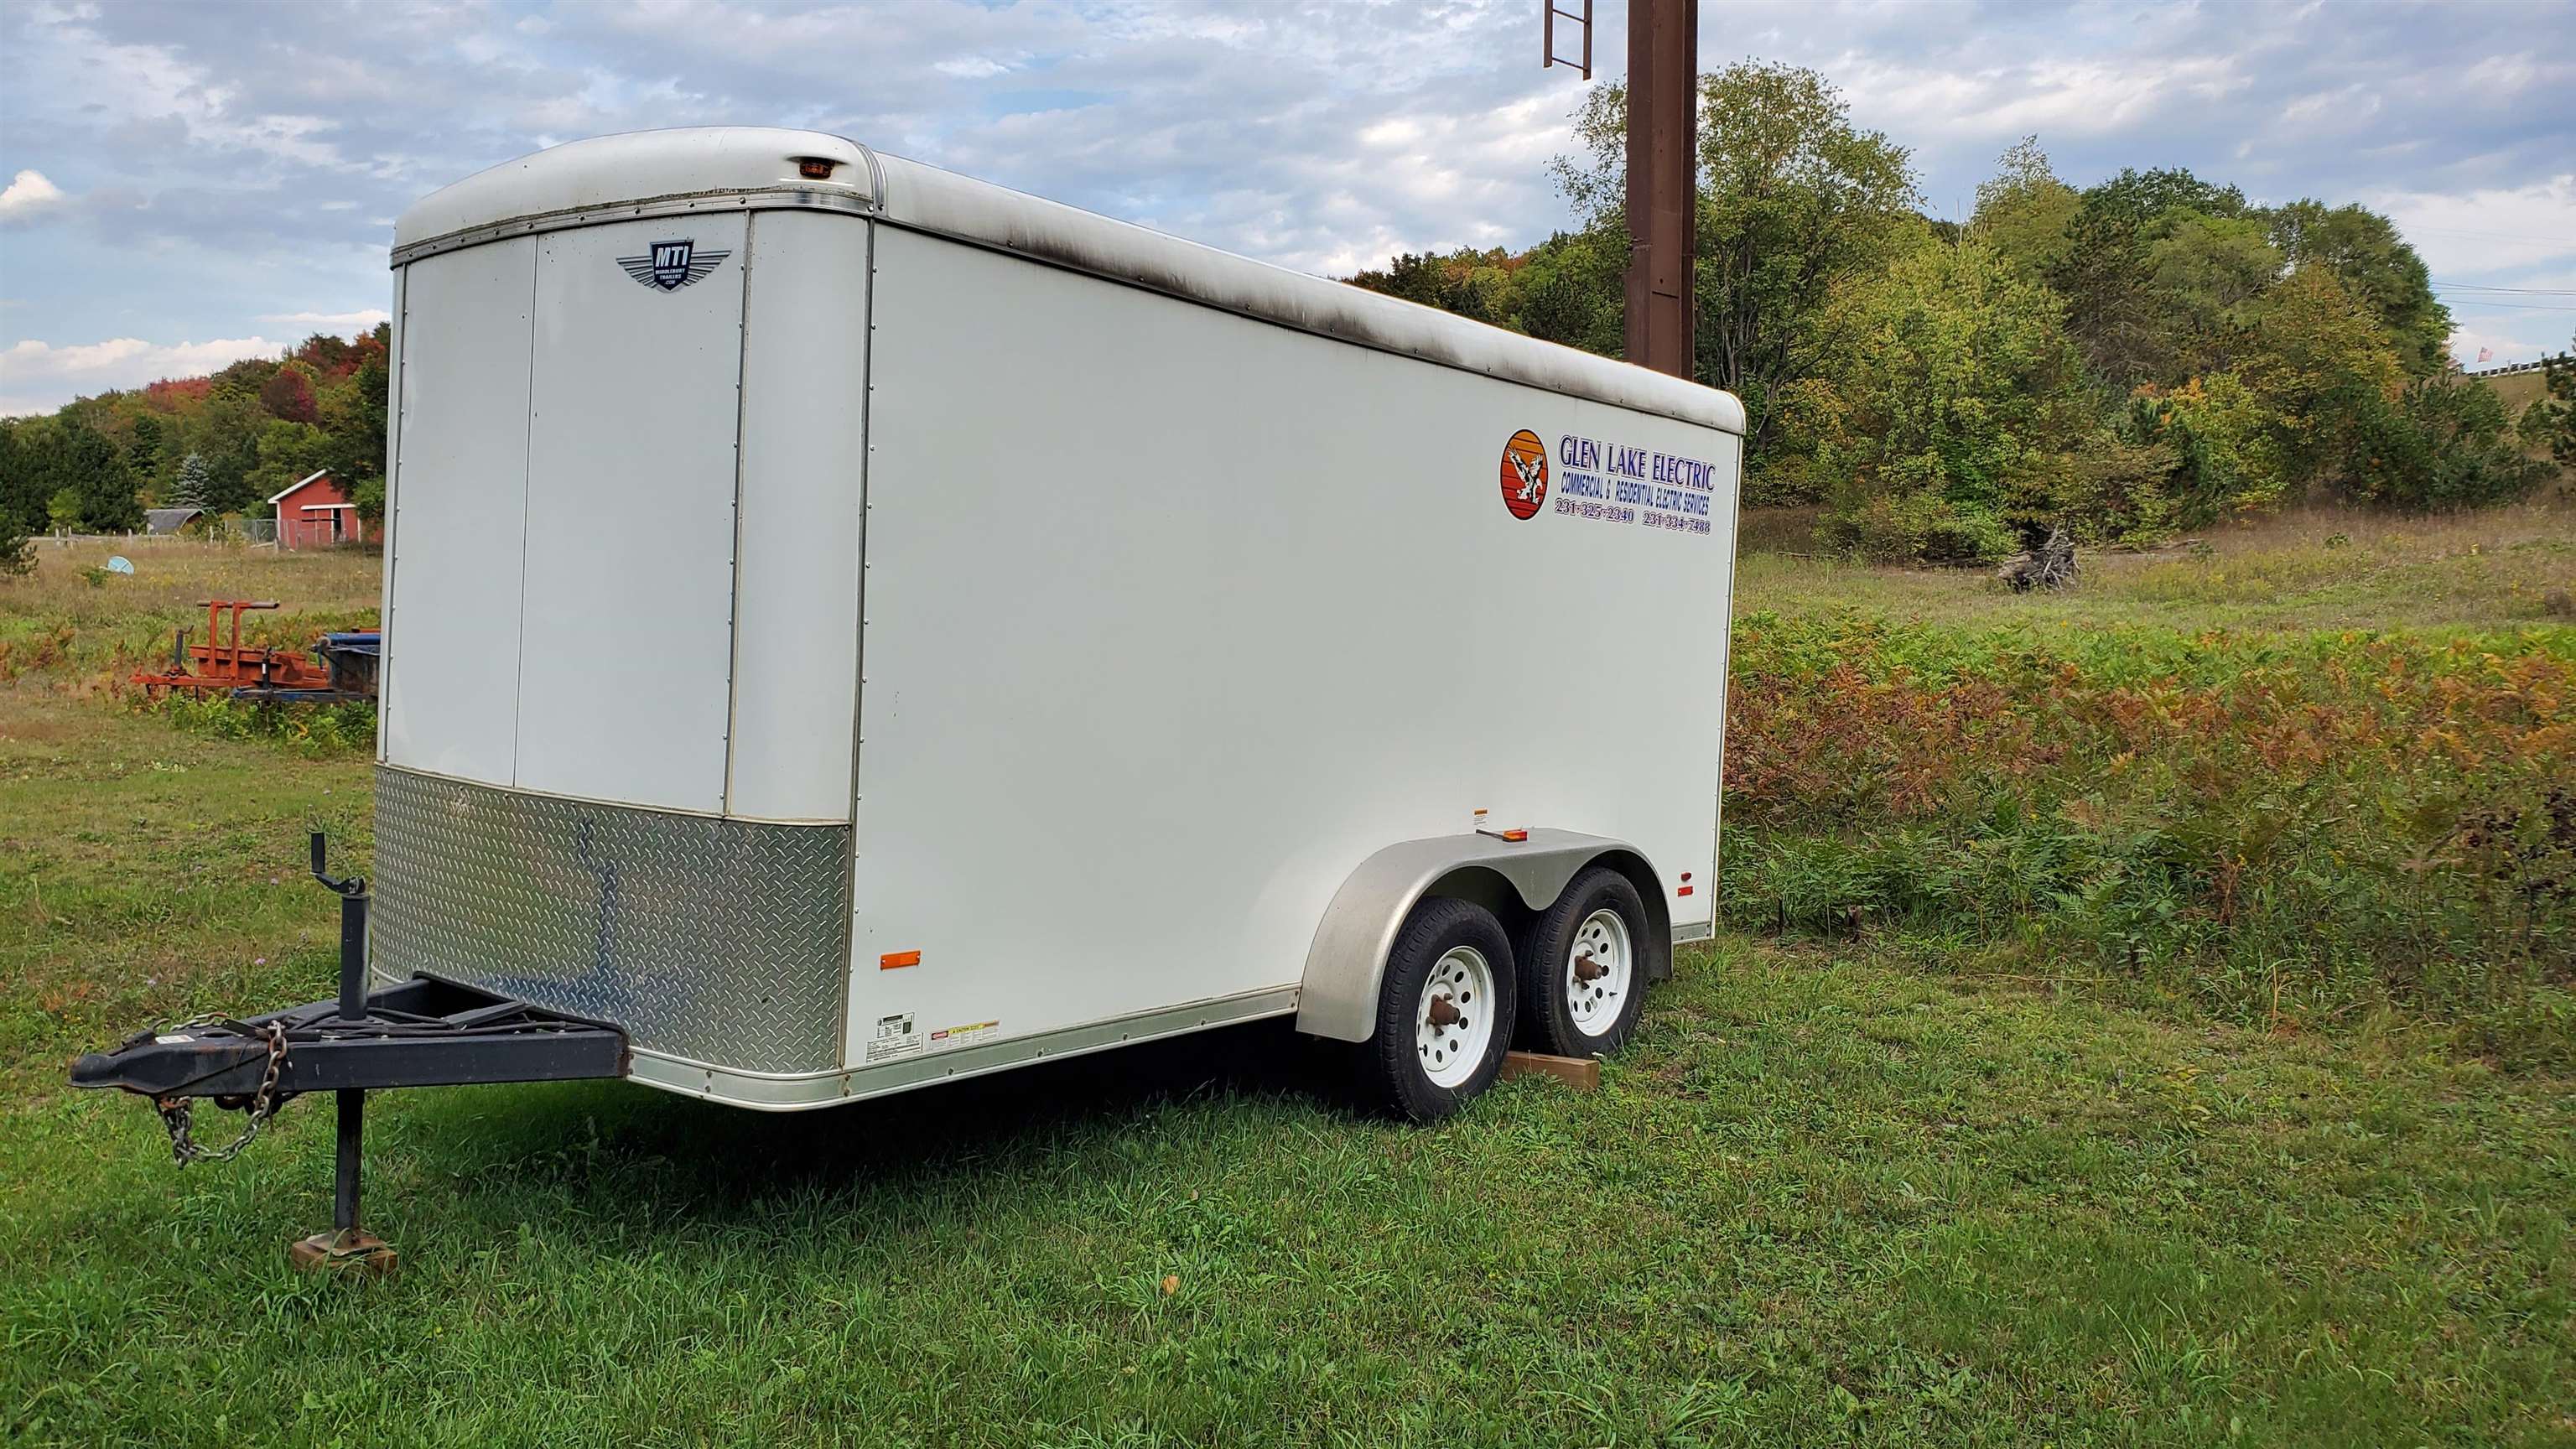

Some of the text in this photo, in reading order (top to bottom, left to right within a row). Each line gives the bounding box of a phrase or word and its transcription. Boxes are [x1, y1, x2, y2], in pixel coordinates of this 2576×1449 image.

[655, 246, 689, 267] MTI
[1560, 435, 1716, 491] GLEN LAKE ELECTRIC
[1561, 471, 1603, 500] COMMERCIAL
[1615, 480, 1654, 507] RESIDENTIAL
[1656, 488, 1682, 512] ELECTRIC
[1684, 493, 1710, 517] SERVICES
